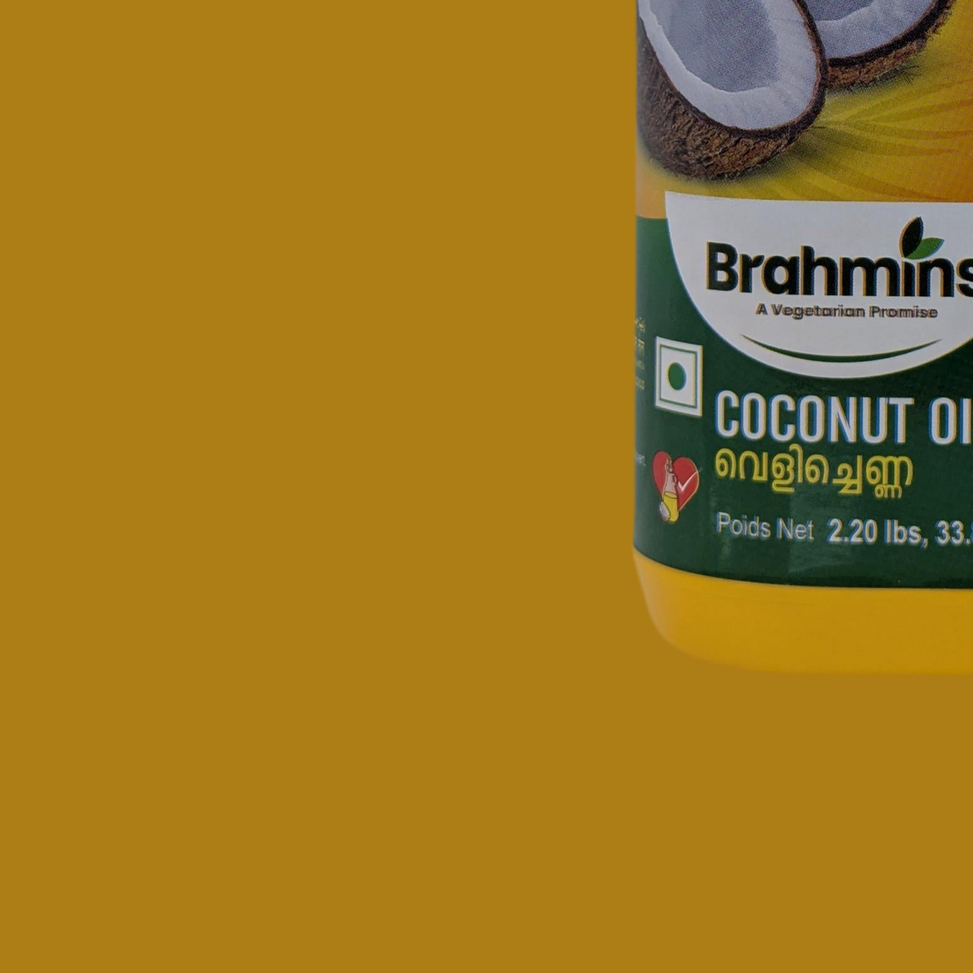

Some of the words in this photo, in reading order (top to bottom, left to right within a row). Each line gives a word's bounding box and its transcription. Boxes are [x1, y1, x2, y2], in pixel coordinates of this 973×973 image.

[756, 303, 767, 315] A
[771, 303, 865, 319] Vegetarian
[869, 305, 937, 318] Promise
[715, 389, 914, 444] COCONUT
[714, 444, 914, 499] വെളിച്ചെണ്ണ
[716, 511, 771, 540] Poids
[776, 516, 815, 543] Net
[827, 517, 879, 545] 2.20
[884, 518, 927, 550] lbs,
